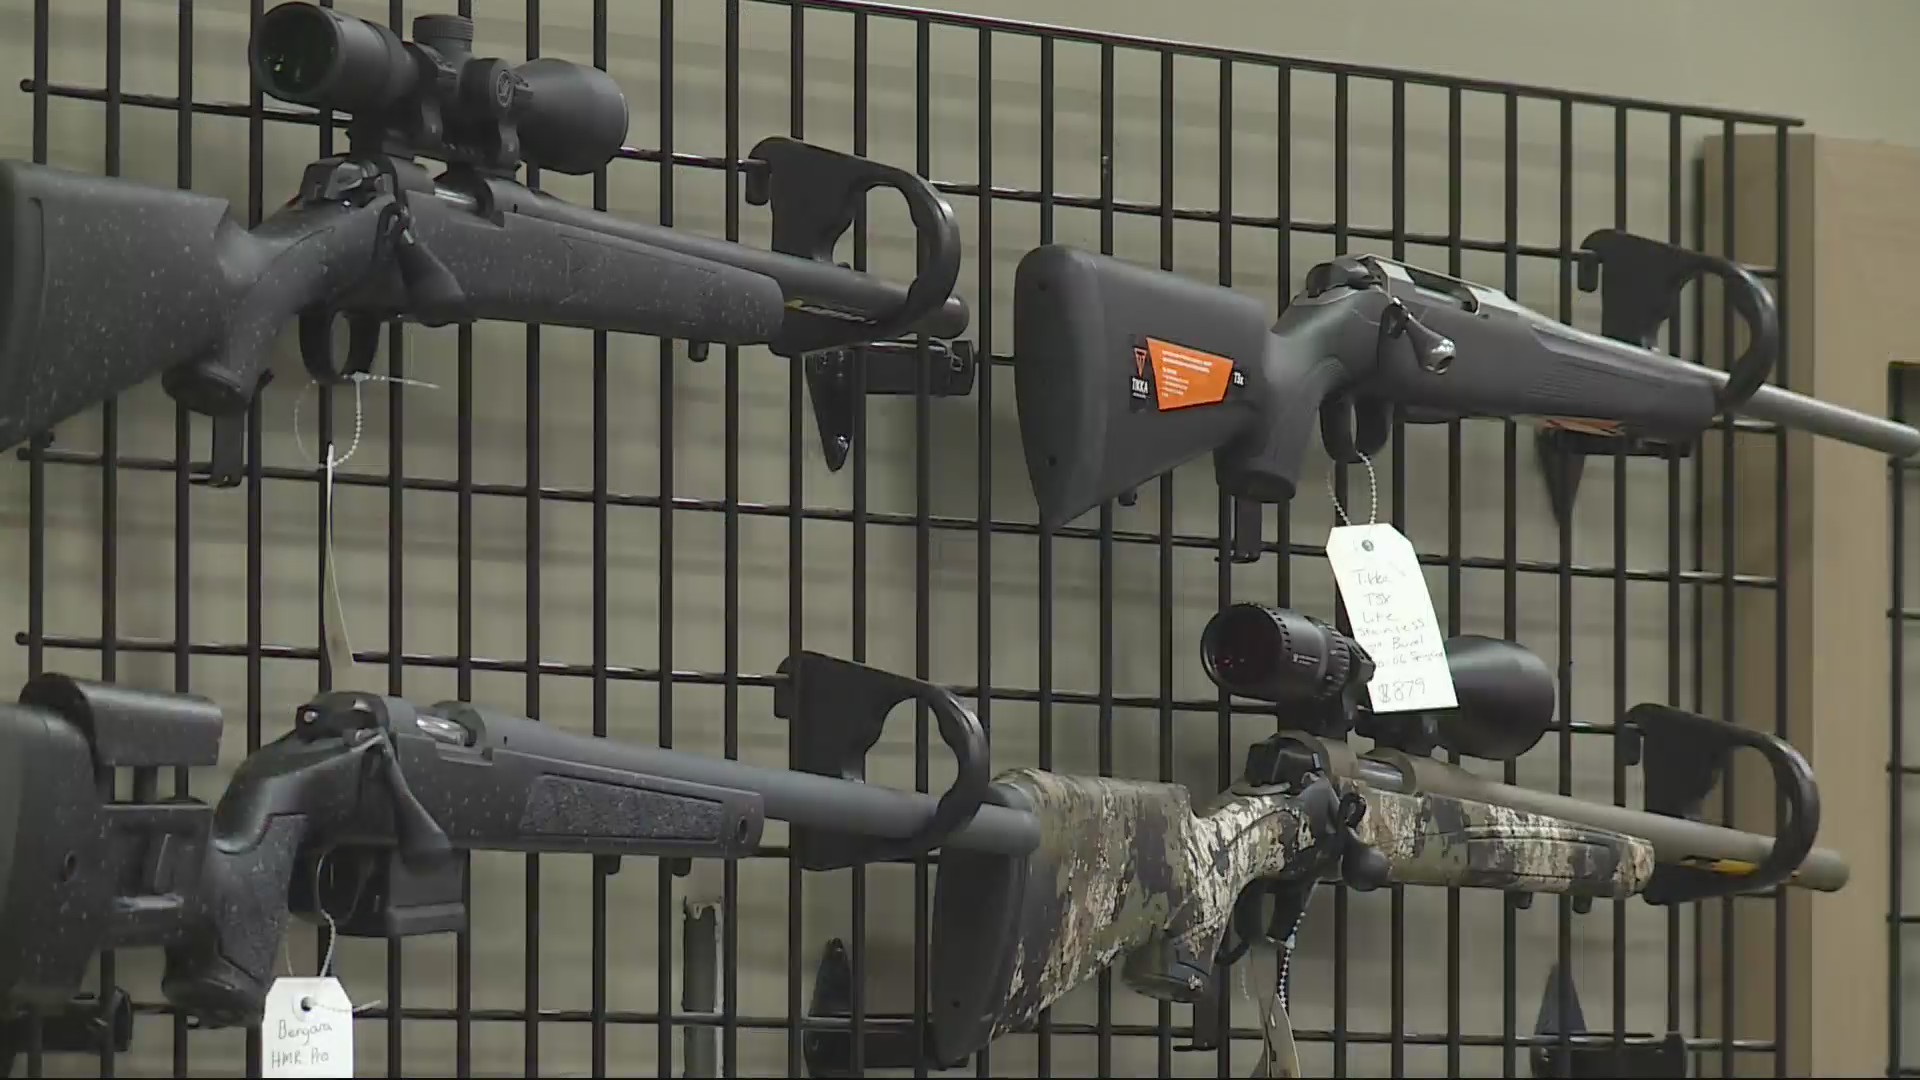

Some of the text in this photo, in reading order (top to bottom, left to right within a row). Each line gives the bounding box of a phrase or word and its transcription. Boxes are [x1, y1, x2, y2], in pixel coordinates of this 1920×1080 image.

[1132, 378, 1149, 394] TIKKA
[1378, 678, 1426, 704] $879
[271, 1047, 330, 1069] HMR Pro
